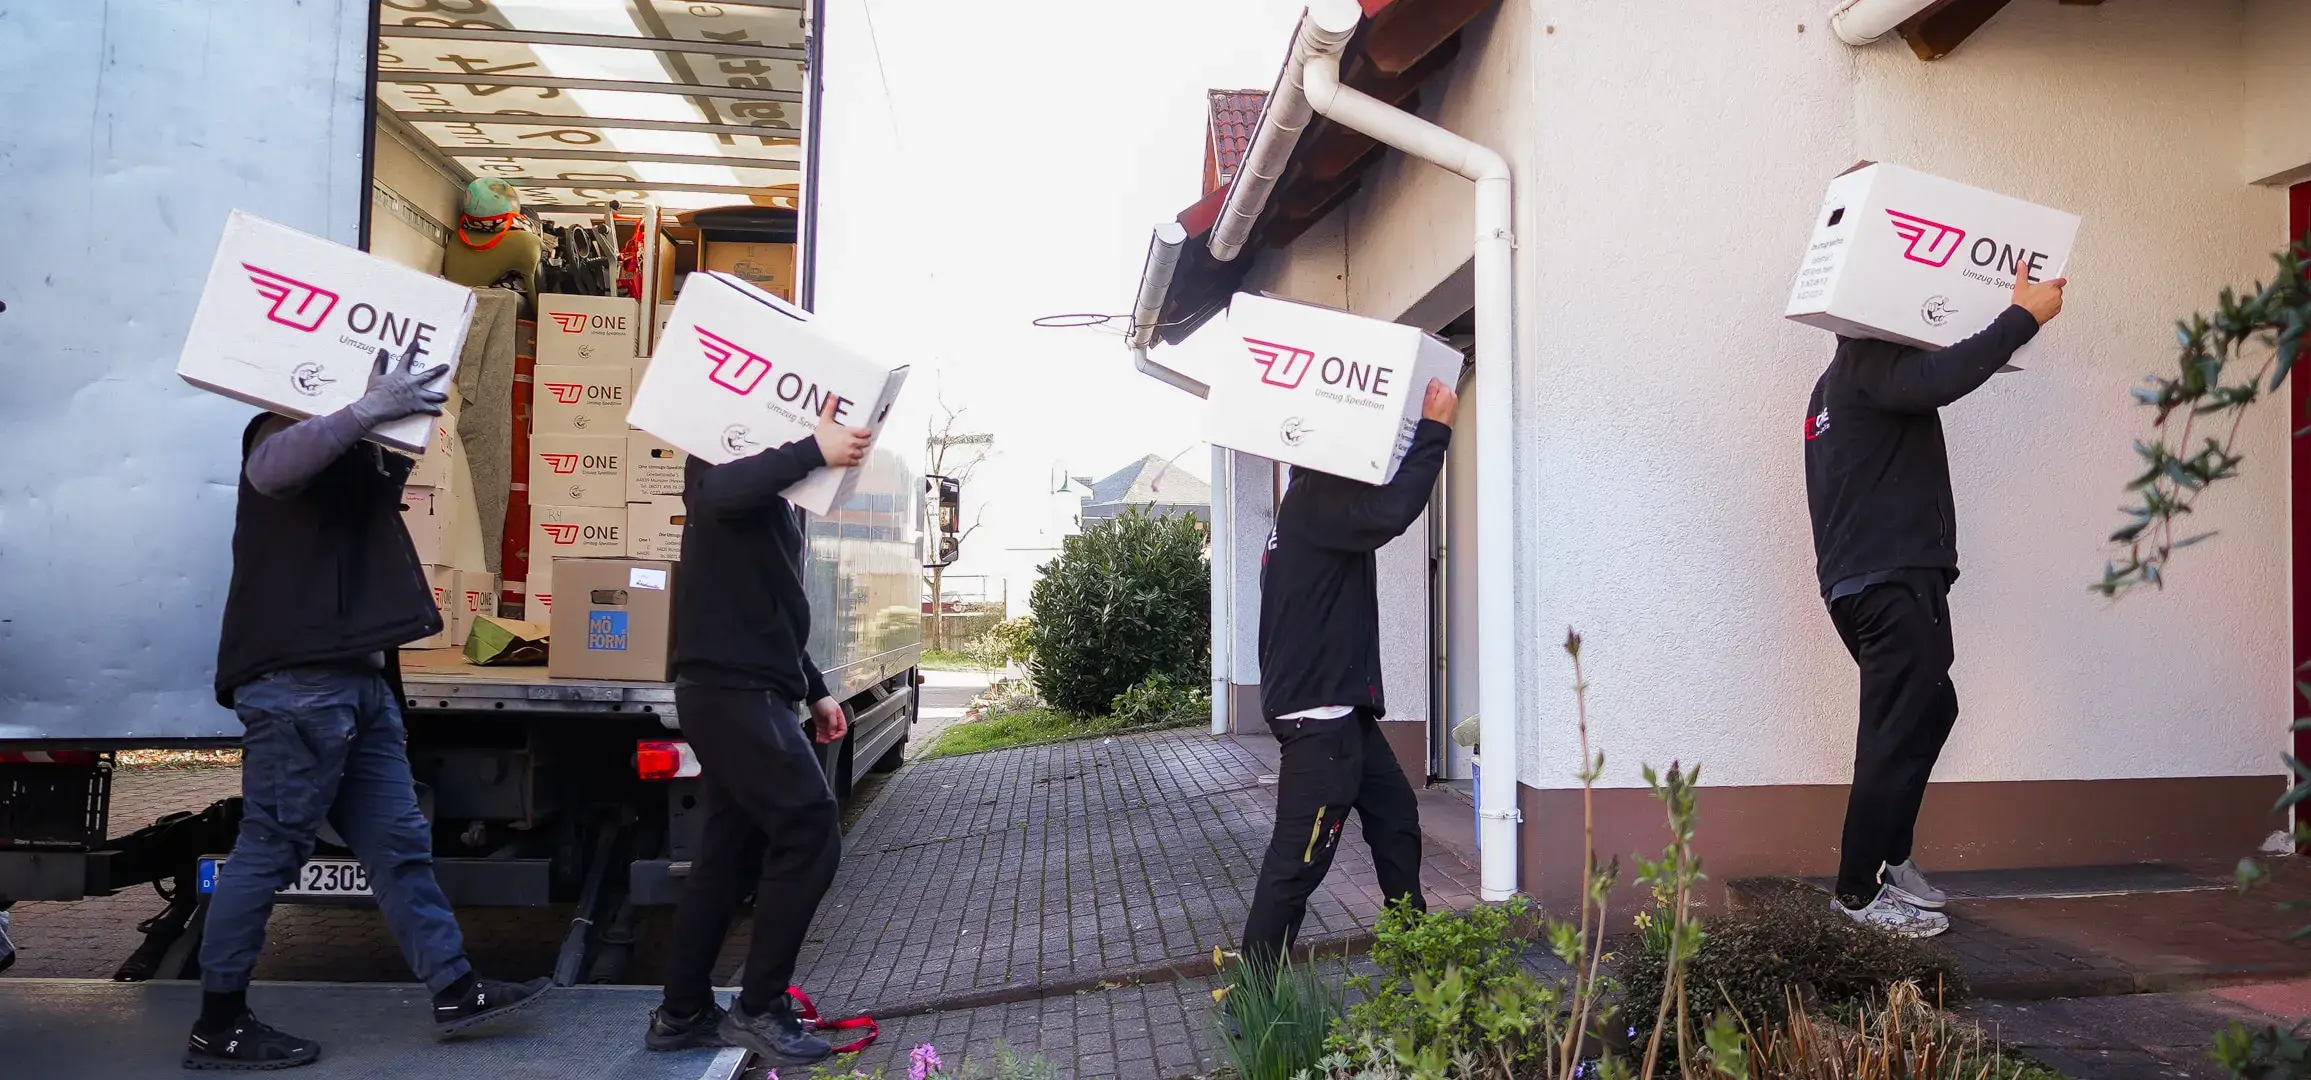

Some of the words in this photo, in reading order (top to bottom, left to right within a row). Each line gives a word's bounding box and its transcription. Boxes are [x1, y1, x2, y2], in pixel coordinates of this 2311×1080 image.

[1970, 237, 2049, 283] ONE
[1962, 268, 1993, 285] Umzug
[347, 302, 437, 356] ONE
[591, 315, 627, 330] ONE
[339, 335, 376, 355] Umzug
[1321, 356, 1393, 397] ONE
[587, 385, 622, 400] ONE
[776, 372, 854, 427] ONE
[1314, 388, 1344, 402] Umzug
[1345, 394, 1385, 410] Spedition
[767, 401, 796, 423] Umzug
[582, 455, 618, 470] ONE
[583, 525, 619, 540] ONE
[480, 592, 492, 606] ONE
[590, 616, 612, 634] MÖ
[589, 634, 626, 649] FORM
[203, 880, 210, 888] D
[308, 864, 369, 891] 2305
